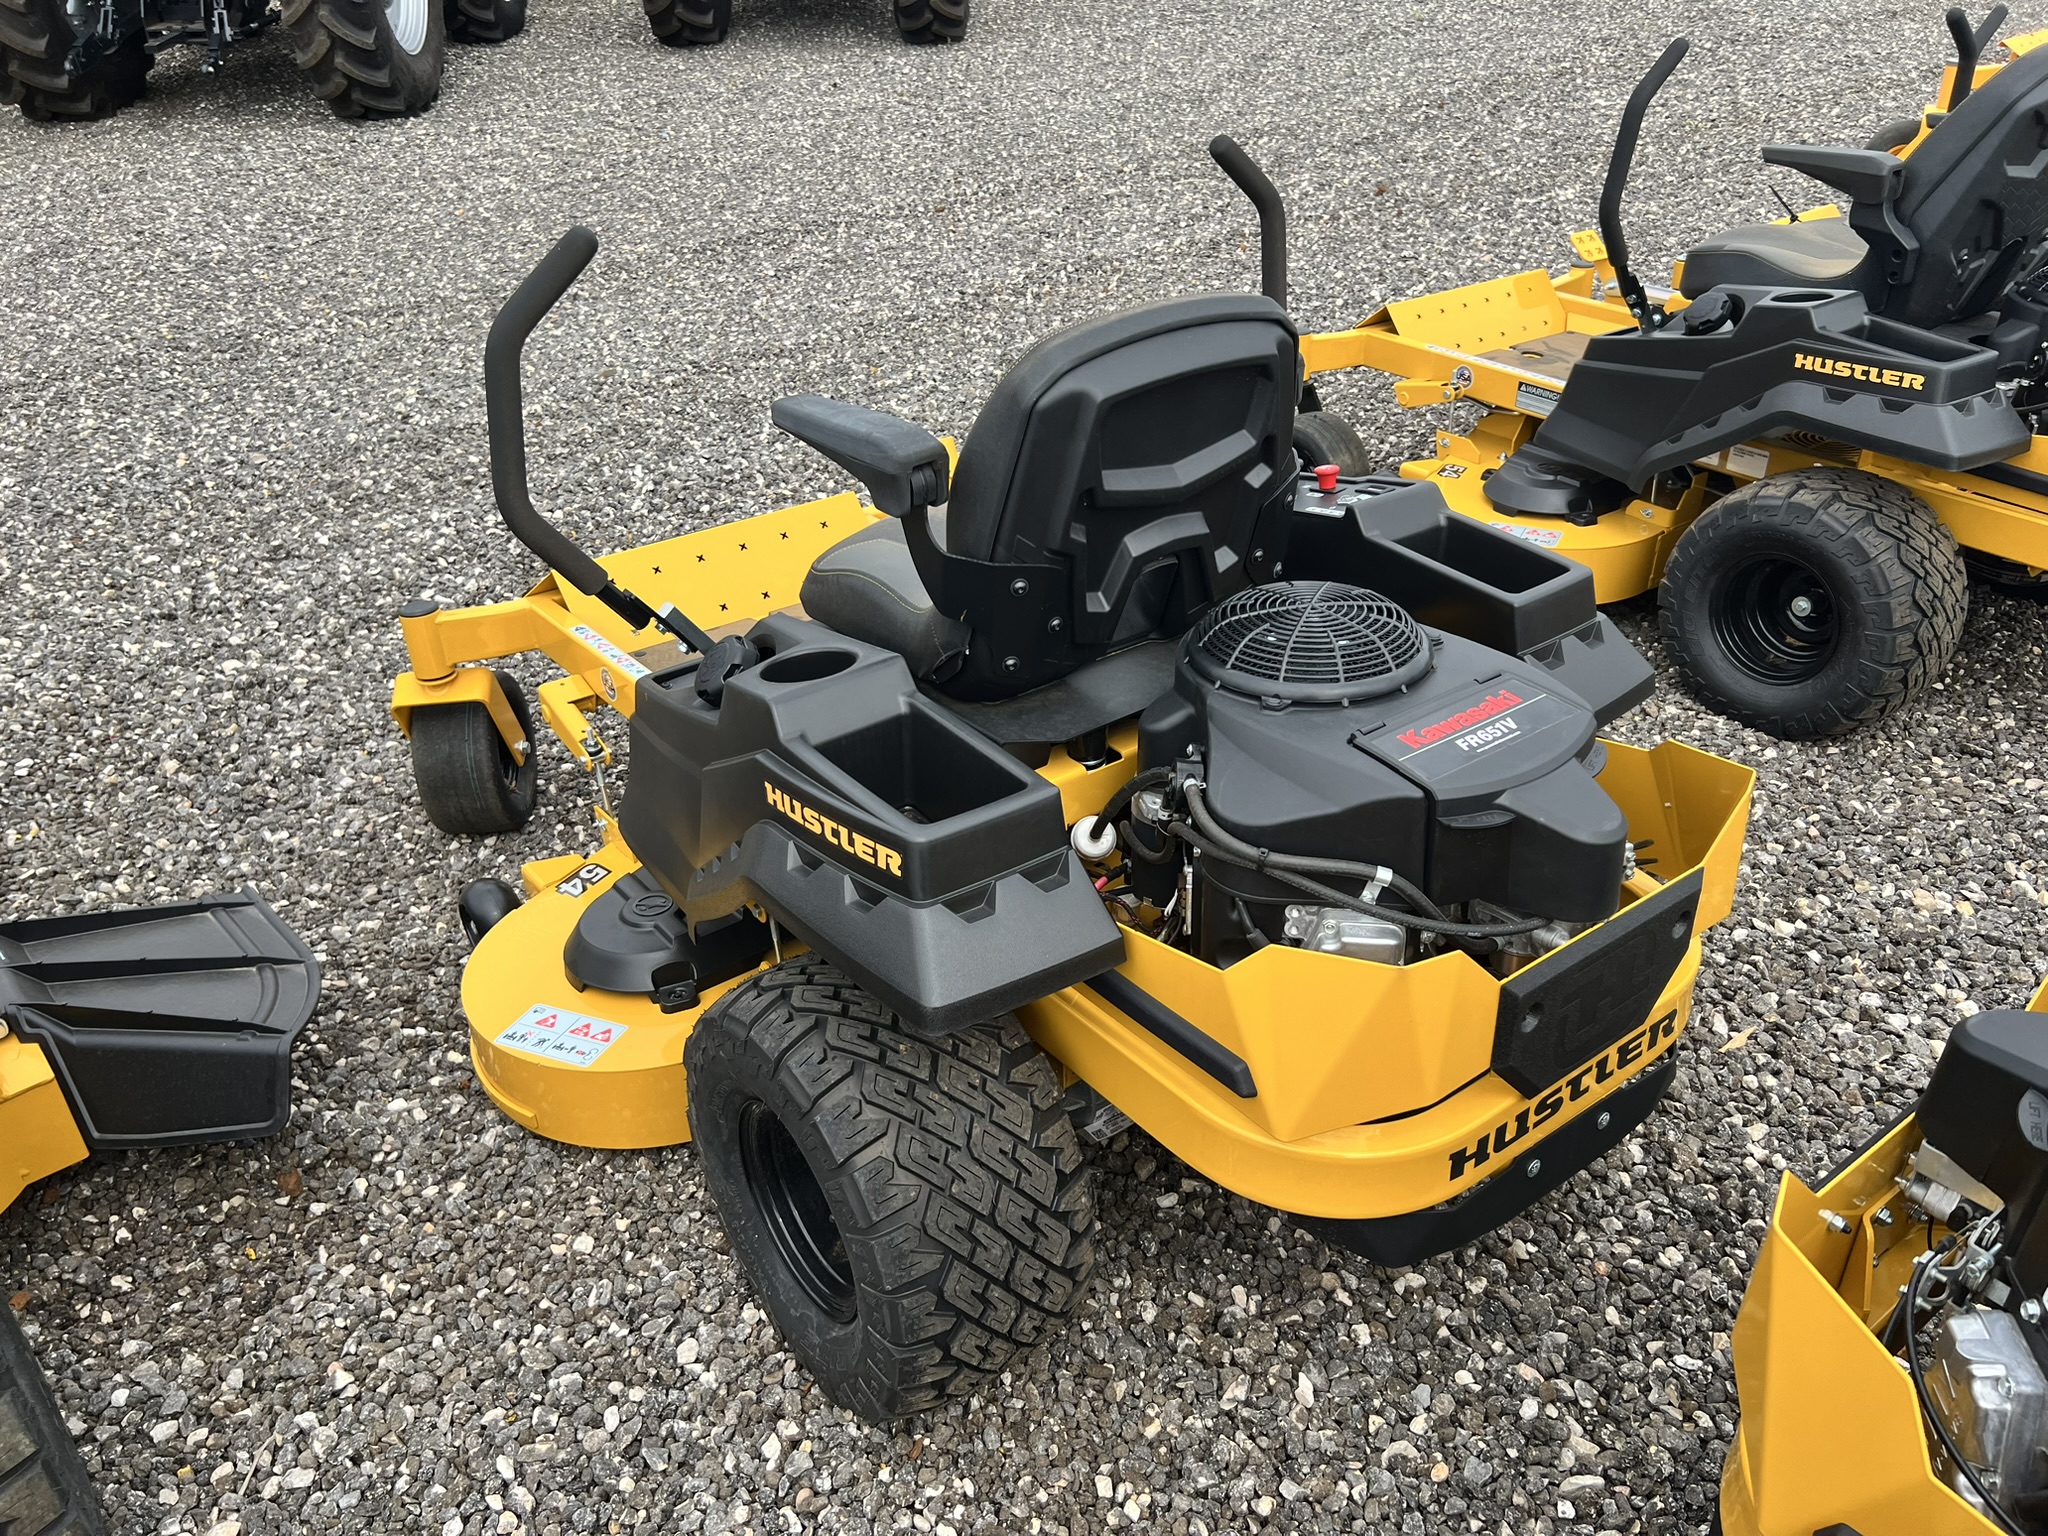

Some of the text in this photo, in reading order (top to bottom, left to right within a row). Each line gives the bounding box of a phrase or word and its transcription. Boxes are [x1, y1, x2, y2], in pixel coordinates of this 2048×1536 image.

[1794, 353, 1925, 391] HUSTLER
[1438, 464, 1467, 479] 54
[1396, 689, 1523, 749] Kawasaki
[1455, 717, 1518, 752] FR651V
[764, 781, 902, 877] HUSTLER
[556, 863, 610, 897] 54
[1449, 1008, 1678, 1182] HUSTLER
